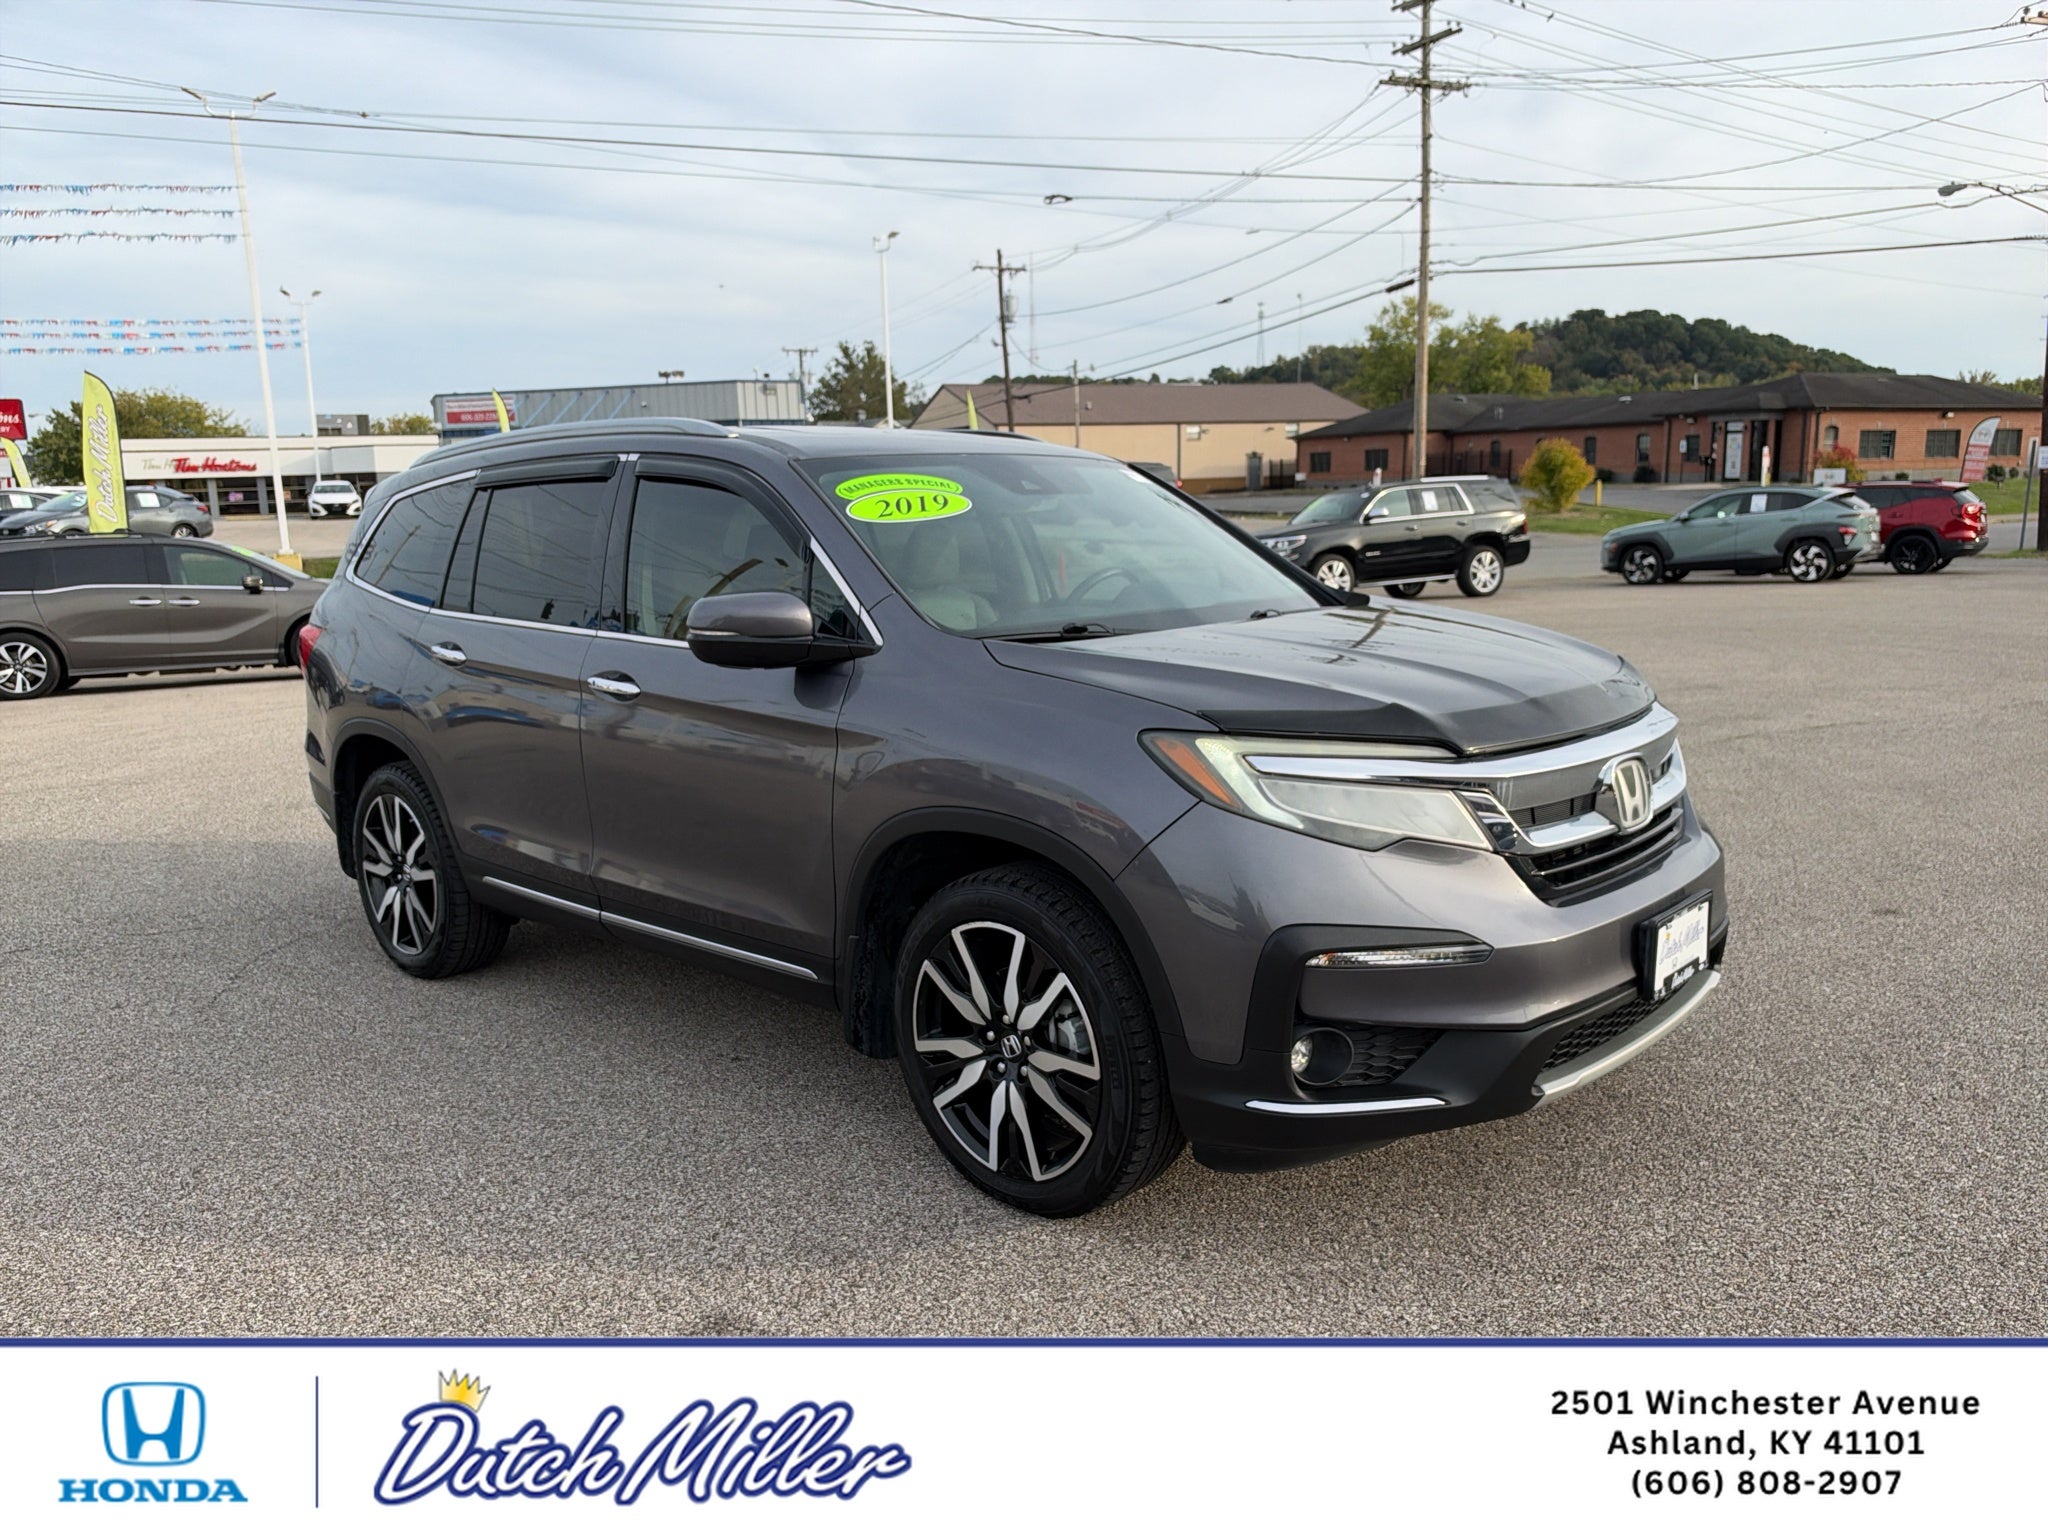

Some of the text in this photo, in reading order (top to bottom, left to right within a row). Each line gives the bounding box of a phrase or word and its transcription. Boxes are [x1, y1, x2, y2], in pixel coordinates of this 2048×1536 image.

[172, 457, 201, 473] Tim
[201, 456, 257, 472] Hortons
[904, 478, 954, 490] SPECIAL
[875, 494, 949, 518] 2019
